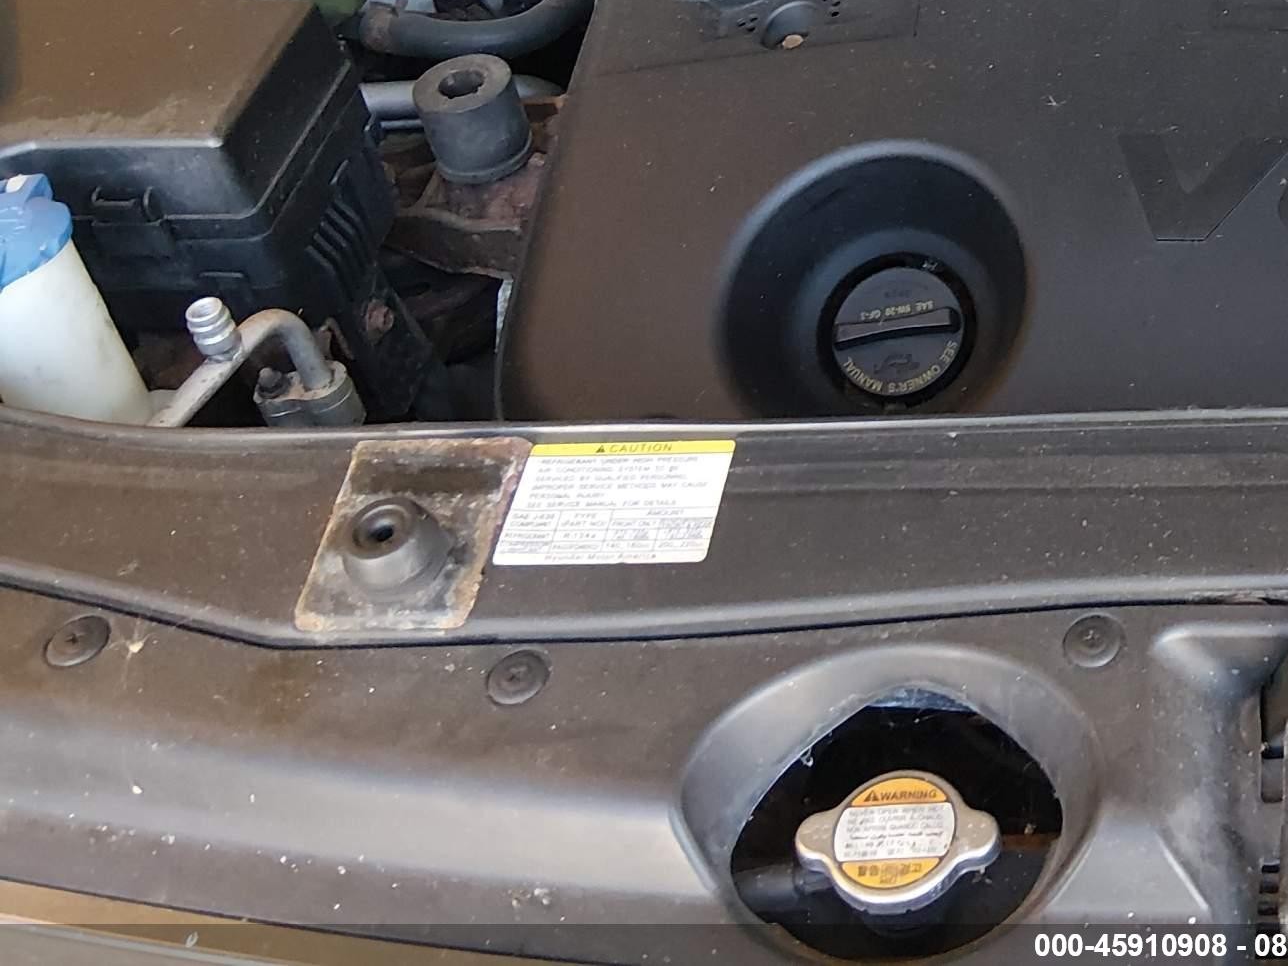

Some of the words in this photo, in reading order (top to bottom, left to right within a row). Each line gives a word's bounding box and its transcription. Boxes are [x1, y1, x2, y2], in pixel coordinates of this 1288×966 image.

[940, 340, 958, 363] SEE
[843, 356, 884, 392] MANUAL
[888, 365, 941, 393] OWNER'S
[608, 442, 673, 453] CAUTION
[881, 789, 936, 801] WARNING
